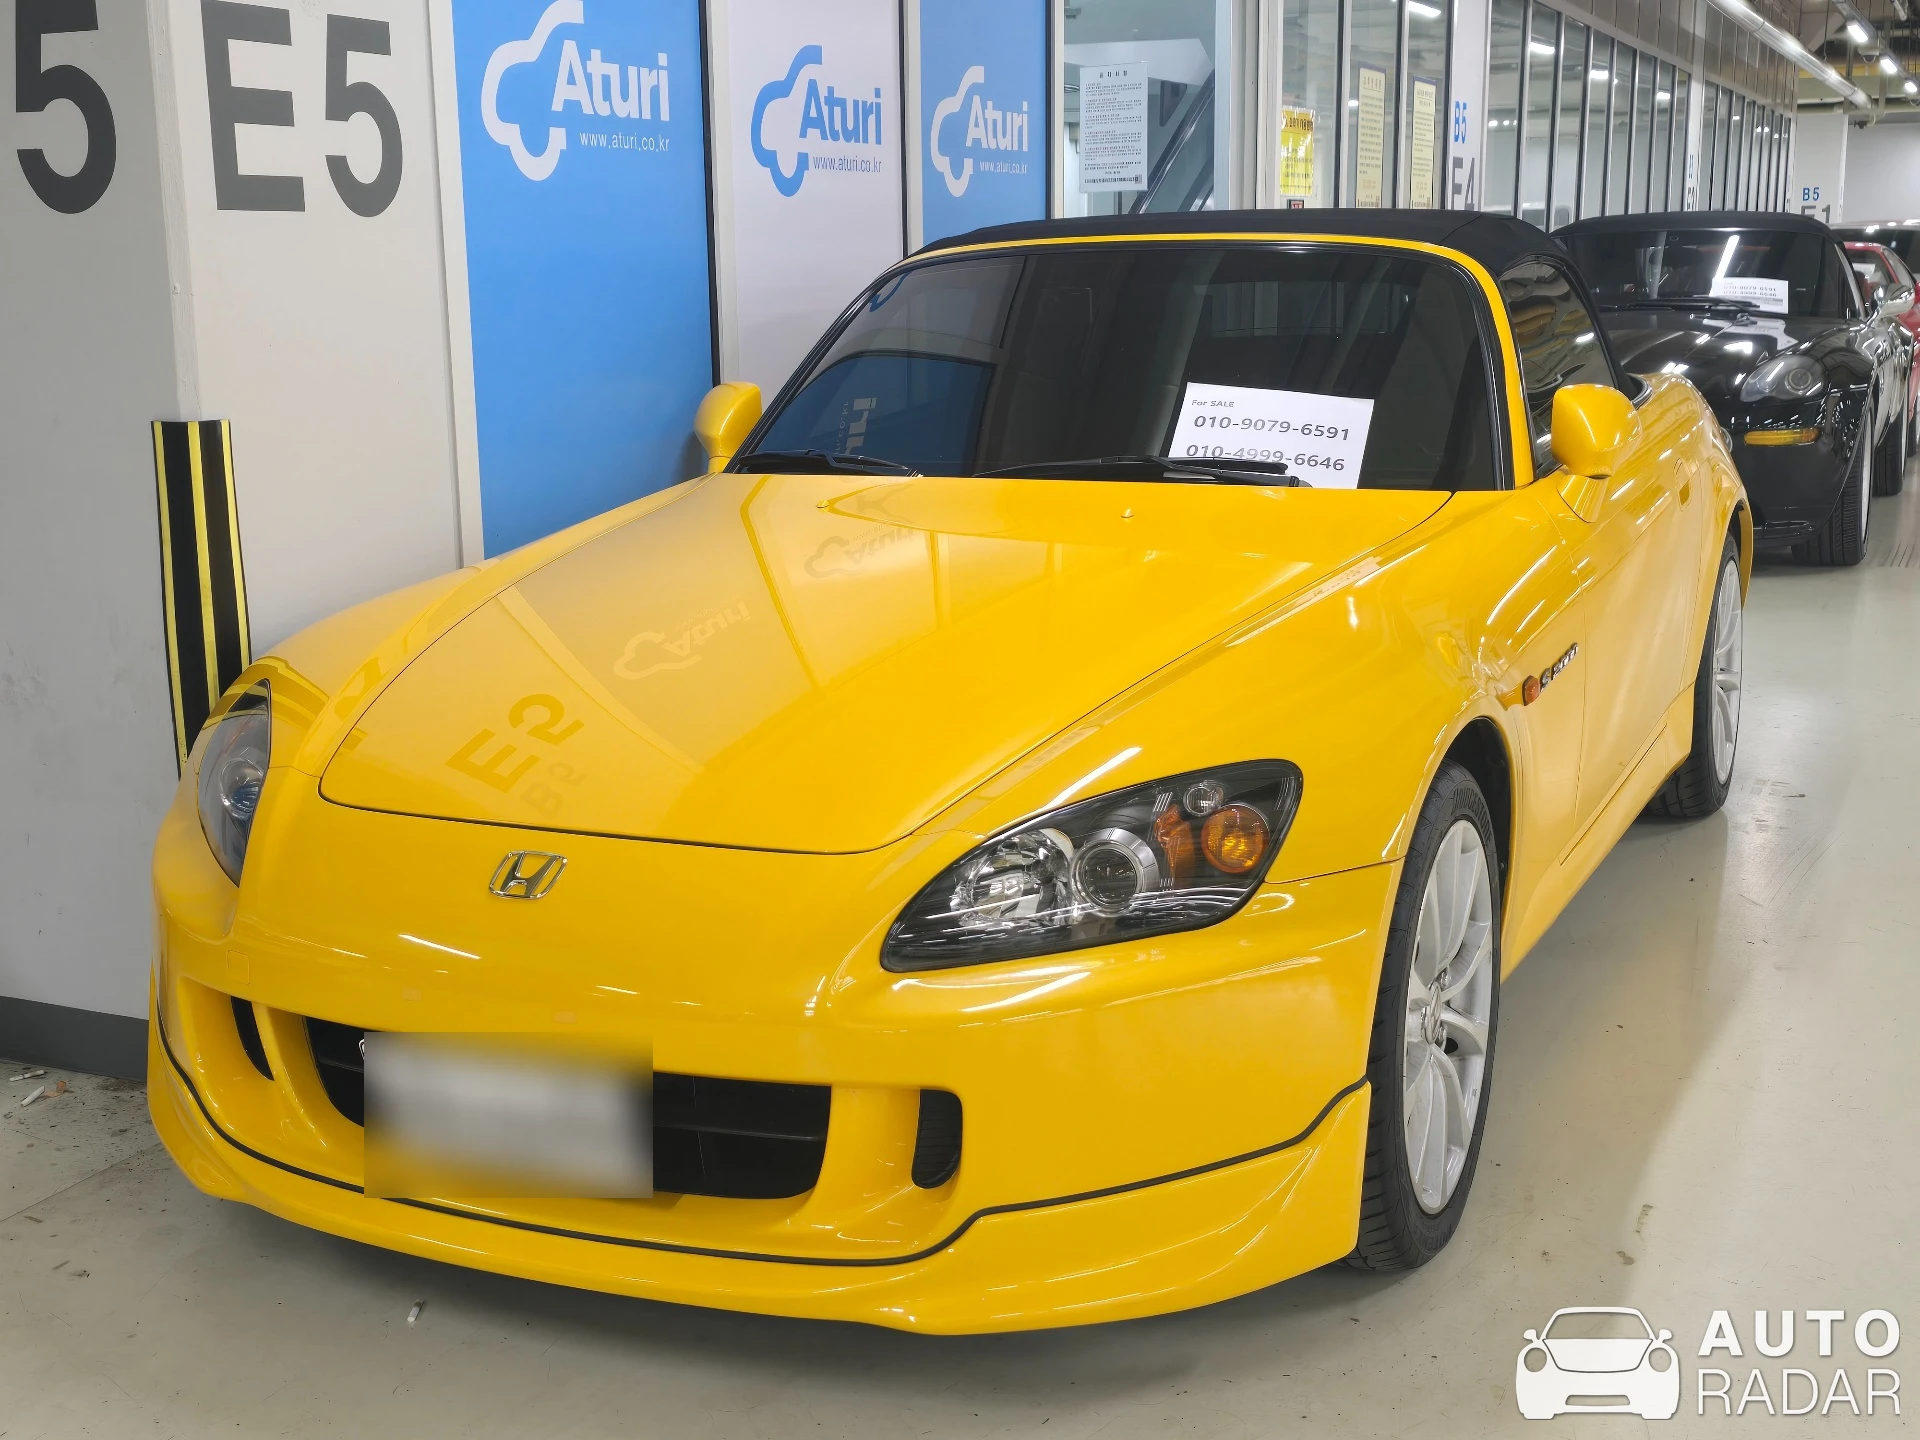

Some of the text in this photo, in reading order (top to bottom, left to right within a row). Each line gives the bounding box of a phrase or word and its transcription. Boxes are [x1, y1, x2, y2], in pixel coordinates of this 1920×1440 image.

[551, 39, 670, 122] Aturi
[15, 0, 117, 215] 5
[200, 0, 404, 218] E5
[798, 78, 882, 146] Aturi
[965, 94, 1028, 152] Aturi
[1453, 100, 1468, 145] B5
[579, 131, 671, 153] www.aturi.co.kr
[812, 154, 882, 174] www.aturi.co.kr
[979, 160, 1028, 175] www.aturi.co.kr
[1801, 186, 1821, 202] B5
[1191, 399, 1235, 408] For SALE
[1193, 415, 1350, 441] 010-9079-6591
[1186, 444, 1346, 471] 010-4999-6646
